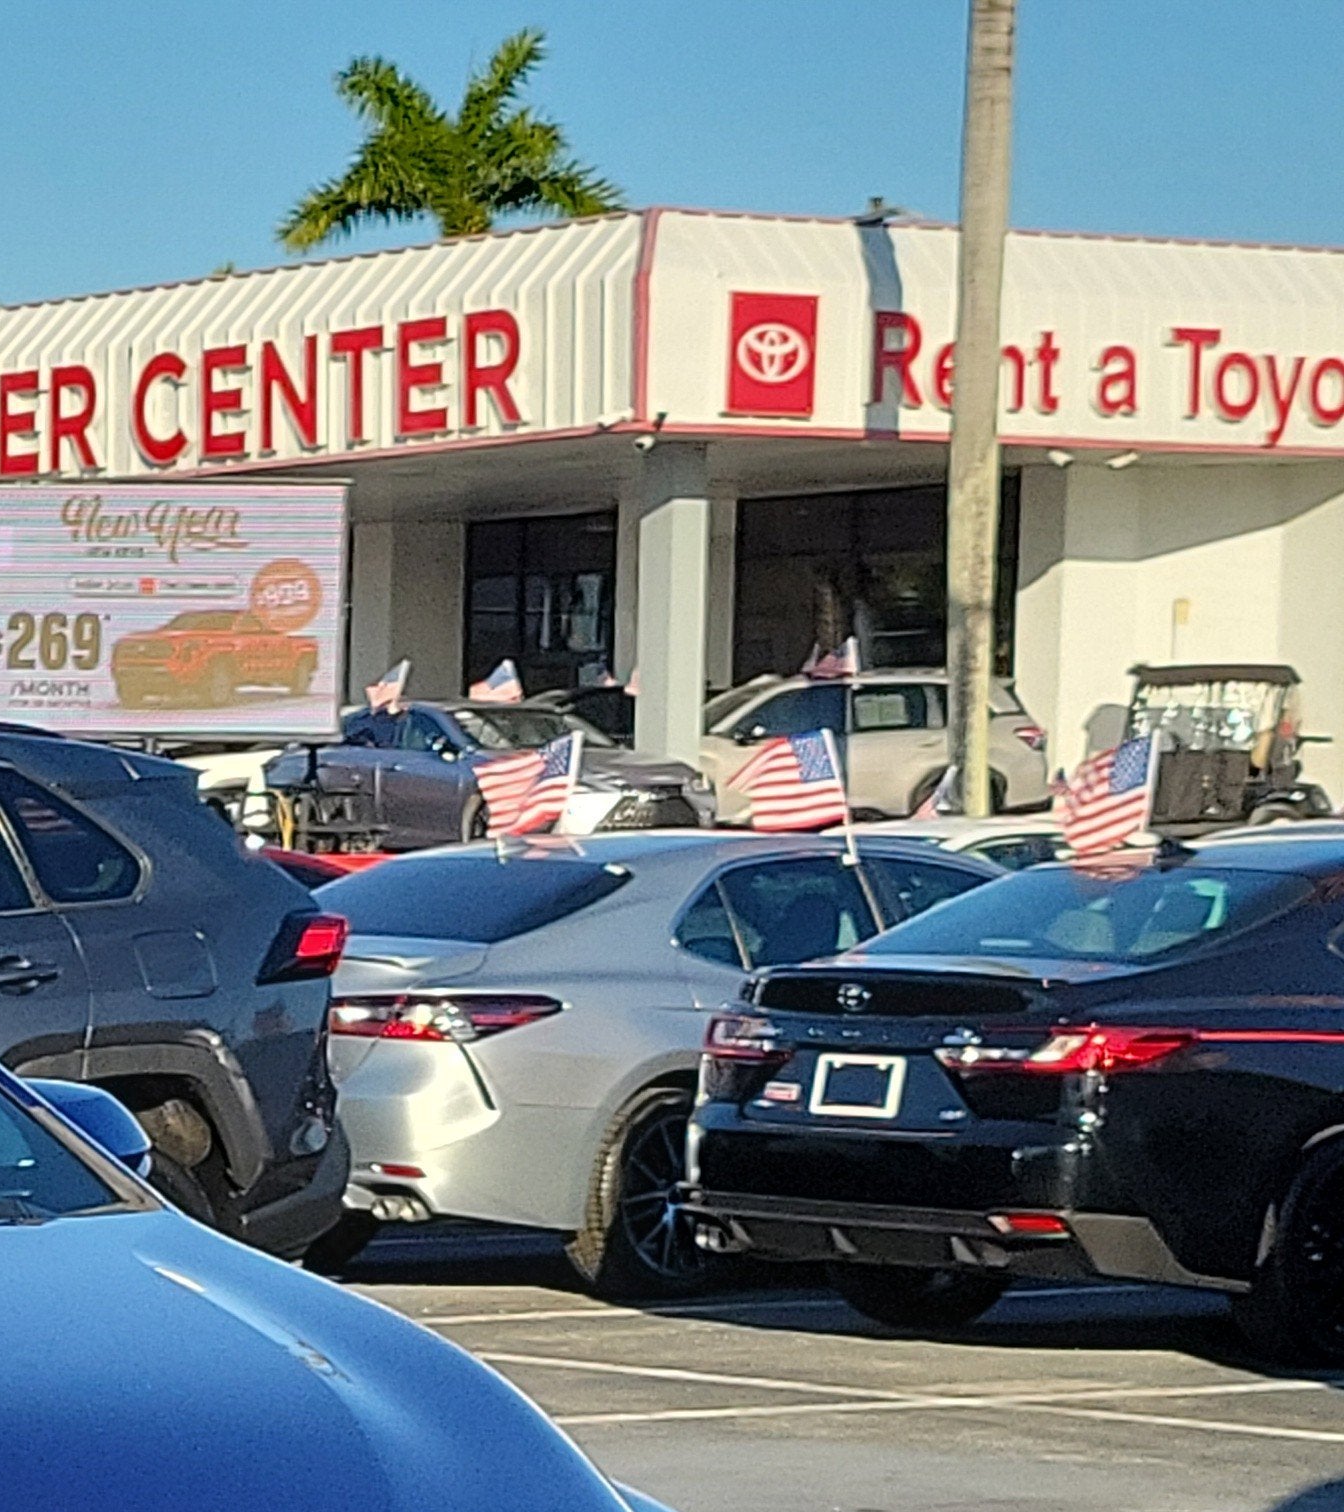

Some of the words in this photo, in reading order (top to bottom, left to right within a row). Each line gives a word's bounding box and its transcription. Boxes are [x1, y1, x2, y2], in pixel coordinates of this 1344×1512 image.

[132, 309, 523, 464] CENTER
[1097, 345, 1138, 417] a
[1171, 328, 1344, 447] Toyo
[60, 495, 140, 542] New
